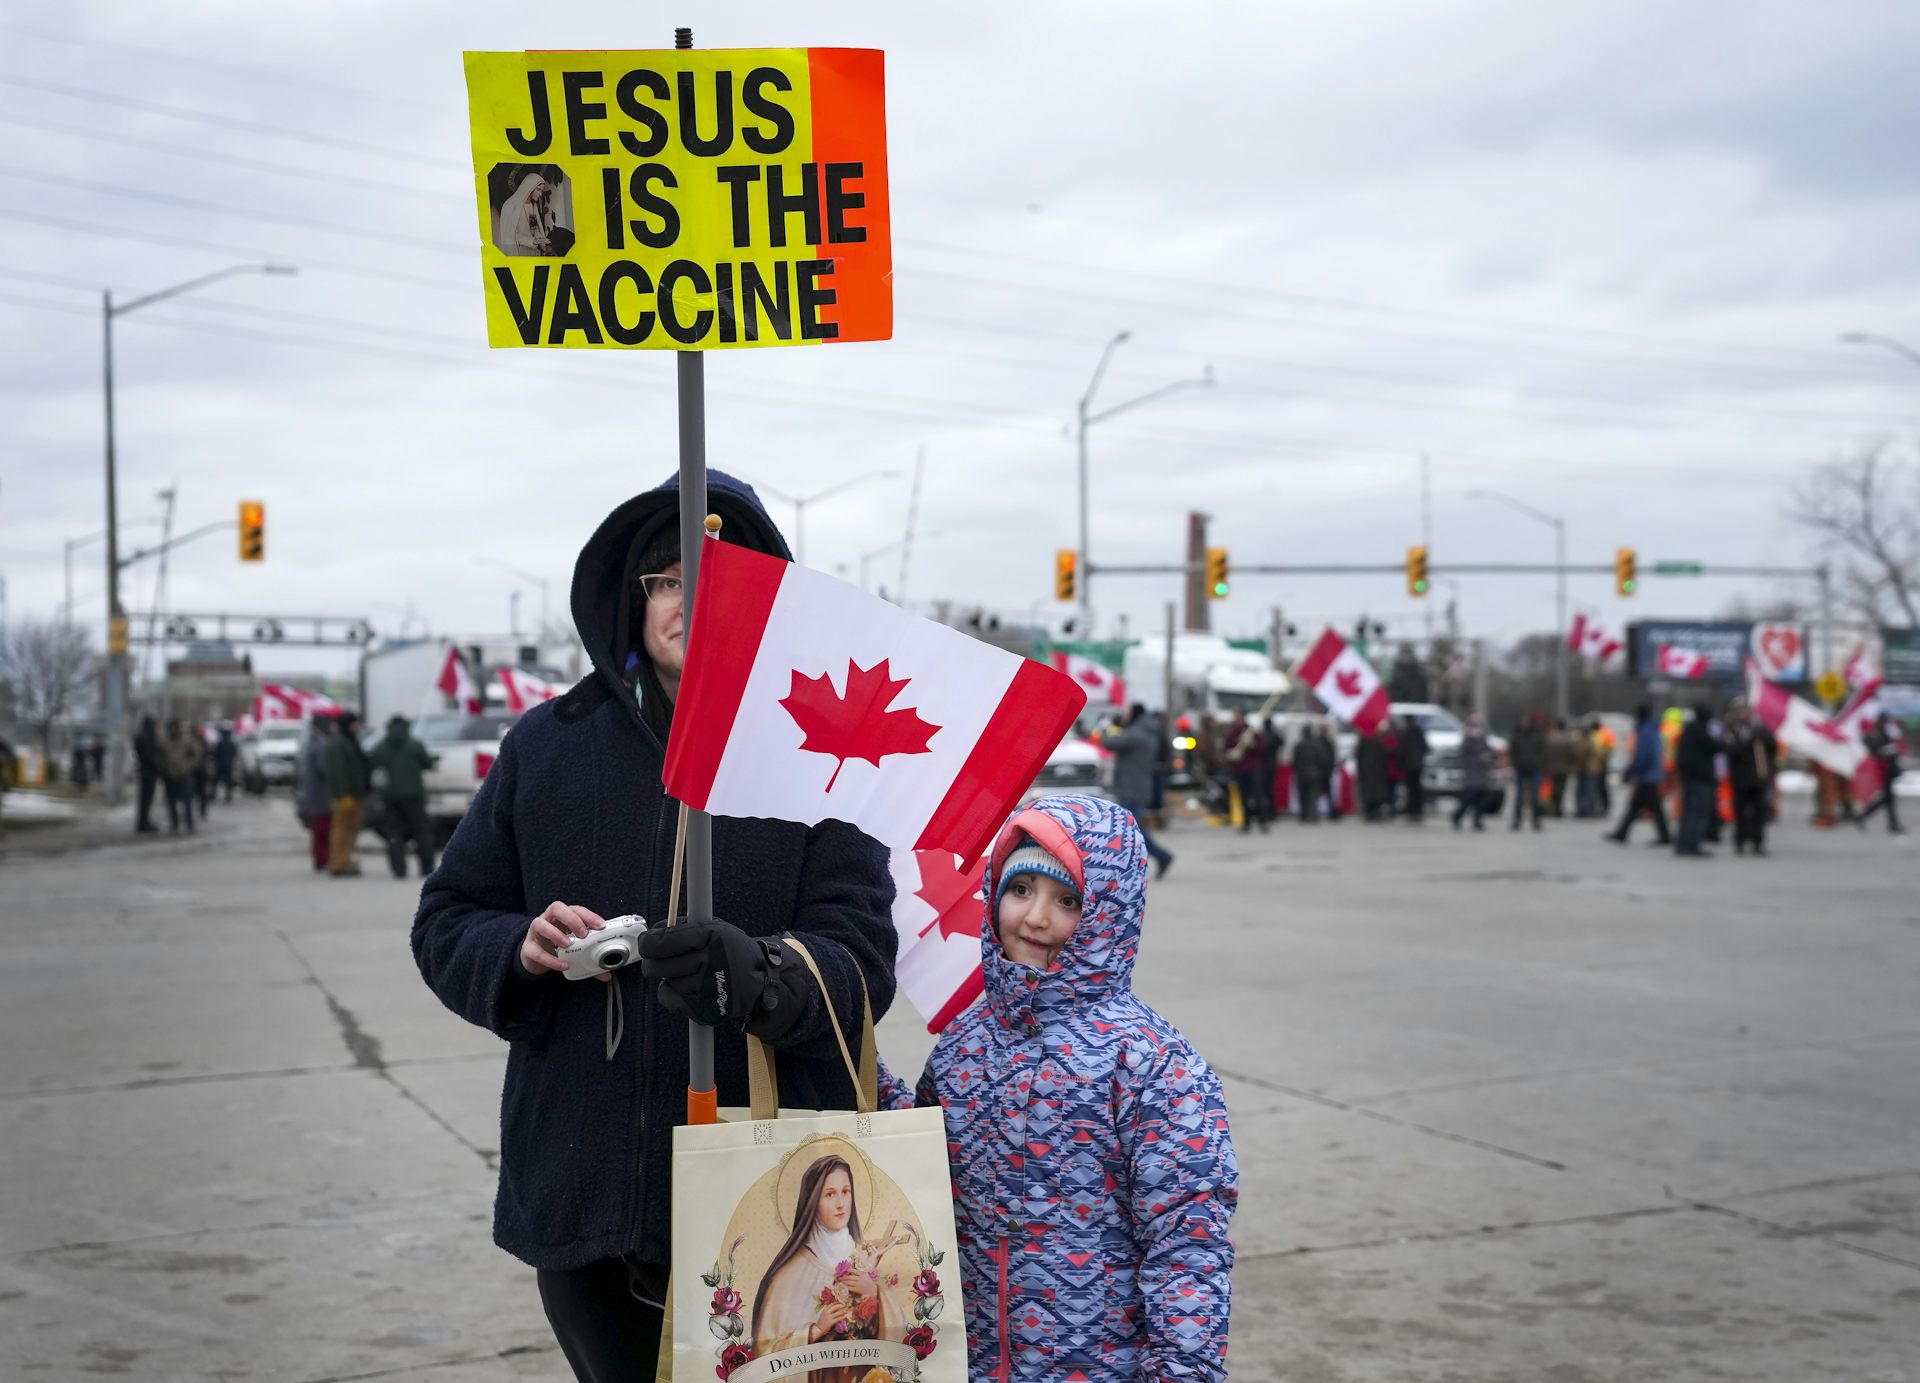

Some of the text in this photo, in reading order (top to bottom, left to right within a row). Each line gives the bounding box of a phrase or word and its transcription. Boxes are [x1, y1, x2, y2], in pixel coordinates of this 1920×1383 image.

[506, 67, 794, 157] JESUS
[602, 162, 867, 249] IS THE
[493, 259, 839, 345] VACCINE
[795, 1353, 817, 1365] ALL
[820, 1349, 850, 1359] WITH
[853, 1349, 880, 1358] LOVE
